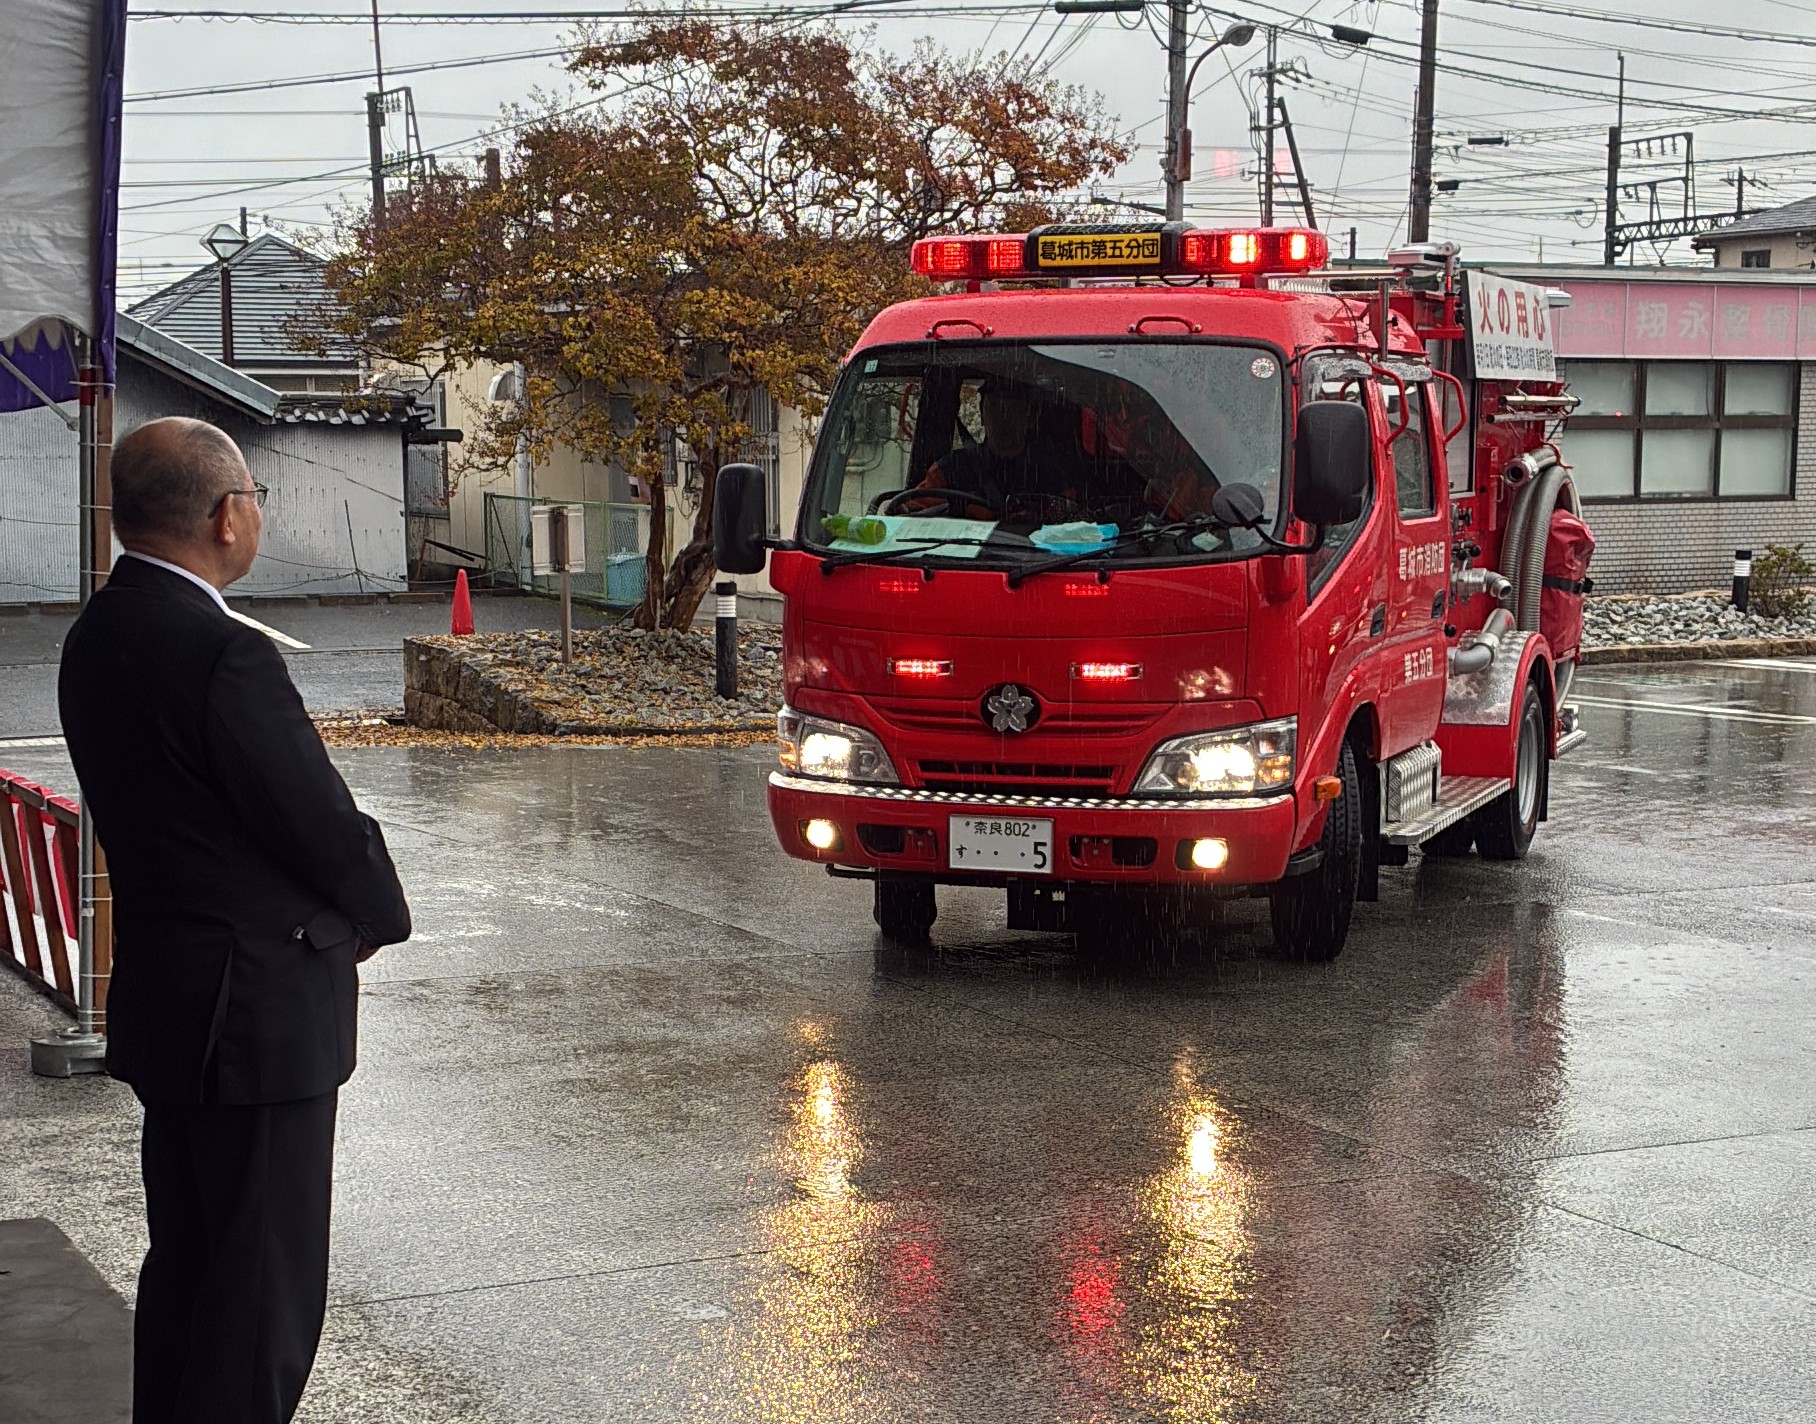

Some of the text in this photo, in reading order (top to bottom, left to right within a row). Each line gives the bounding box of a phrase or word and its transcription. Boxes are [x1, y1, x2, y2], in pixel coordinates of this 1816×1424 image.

[1040, 238, 1159, 261] 葛城市第五分団
[1477, 281, 1546, 342] 火の用心
[1404, 647, 1433, 684] 第五分団
